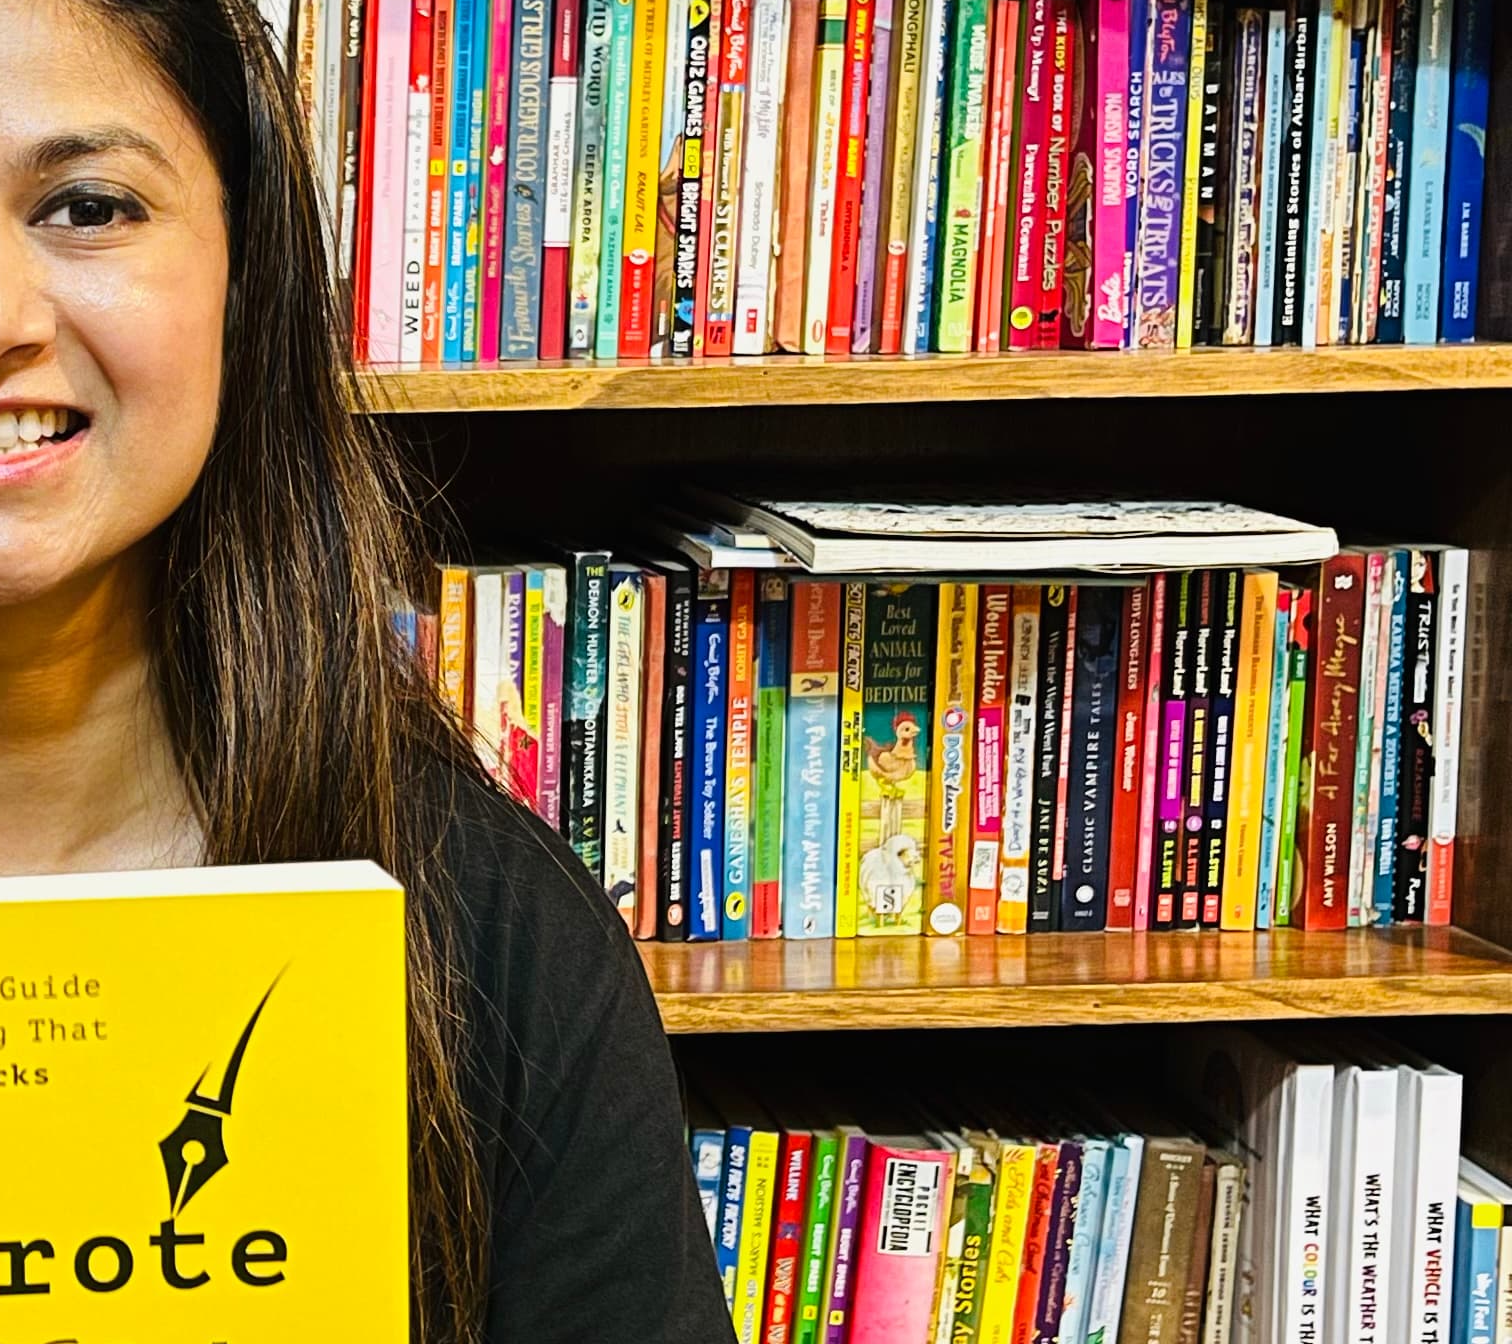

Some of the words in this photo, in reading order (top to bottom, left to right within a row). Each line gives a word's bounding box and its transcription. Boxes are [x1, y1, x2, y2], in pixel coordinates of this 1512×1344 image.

[880, 619, 916, 636] Loved
[886, 604, 911, 621] Best
[869, 641, 923, 658] ANIMAL
[871, 663, 901, 680] Tales
[903, 662, 922, 679] for
[865, 685, 927, 704] BEDTIME
[1090, 682, 1102, 723] TALES
[1083, 731, 1100, 807] VAMPIRE
[1082, 820, 1096, 873] CLASSIC
[1324, 823, 1337, 871] WILSON
[1322, 873, 1334, 908] AMY
[0, 974, 102, 1002] Guide
[29, 1016, 109, 1044] That
[889, 1162, 917, 1251] ENCYCLOPEDIA
[1304, 1195, 1321, 1236] WHAT
[1364, 1174, 1381, 1226] WHAT'S
[1427, 1202, 1444, 1243] WHAT
[1363, 1233, 1379, 1258] THE
[954, 1235, 981, 1313] Stories
[1302, 1243, 1319, 1296] COLOUR
[1424, 1249, 1442, 1306] VEHICLE
[1301, 1304, 1315, 1315] IS
[1360, 1265, 1377, 1329] WEATHER
[1424, 1312, 1438, 1324] IS
